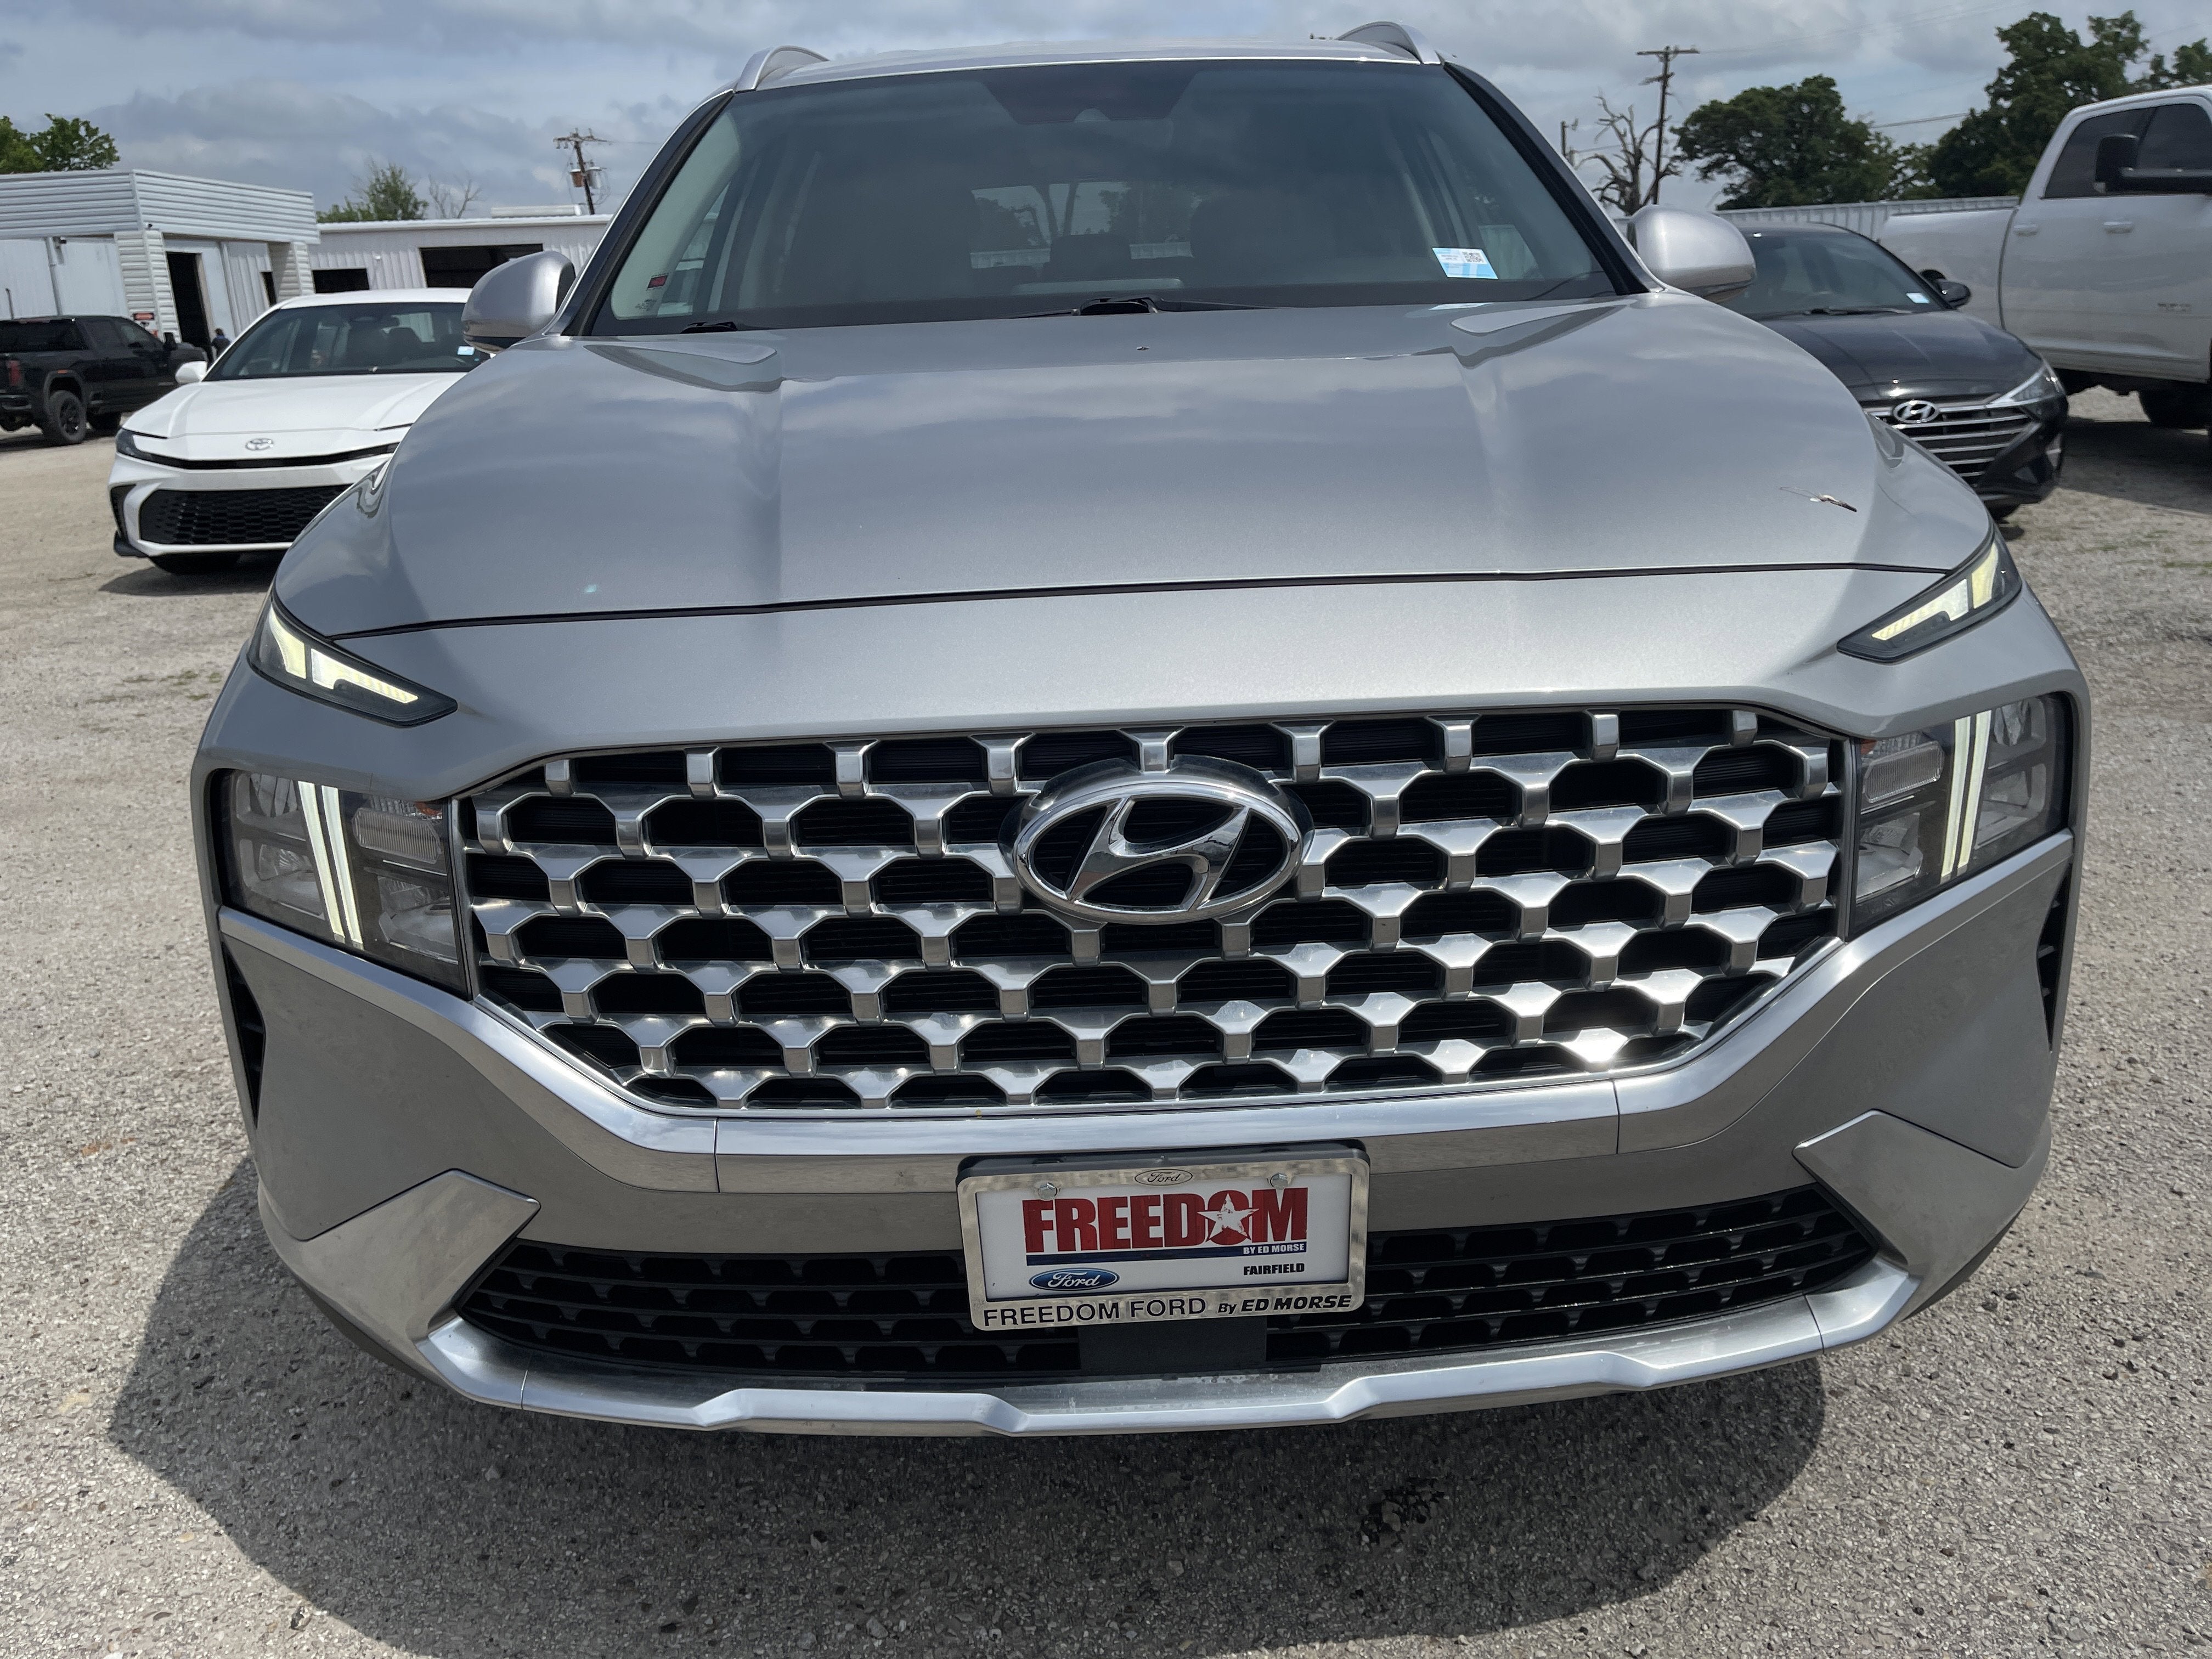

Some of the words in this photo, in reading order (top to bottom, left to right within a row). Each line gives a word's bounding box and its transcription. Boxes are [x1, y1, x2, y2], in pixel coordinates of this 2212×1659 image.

[1147, 1171, 1181, 1183] Ford
[1022, 1187, 1308, 1252] FREEDOM
[1271, 1243, 1305, 1252] MORSE
[1243, 1263, 1305, 1276] FAIRFIELD
[1047, 1272, 1101, 1288] Ford
[984, 1302, 1119, 1326] FREEDOM
[1131, 1298, 1206, 1318] FORD
[1218, 1303, 1237, 1314] By
[1241, 1299, 1269, 1312] ED
[1273, 1295, 1352, 1310] MORSE
